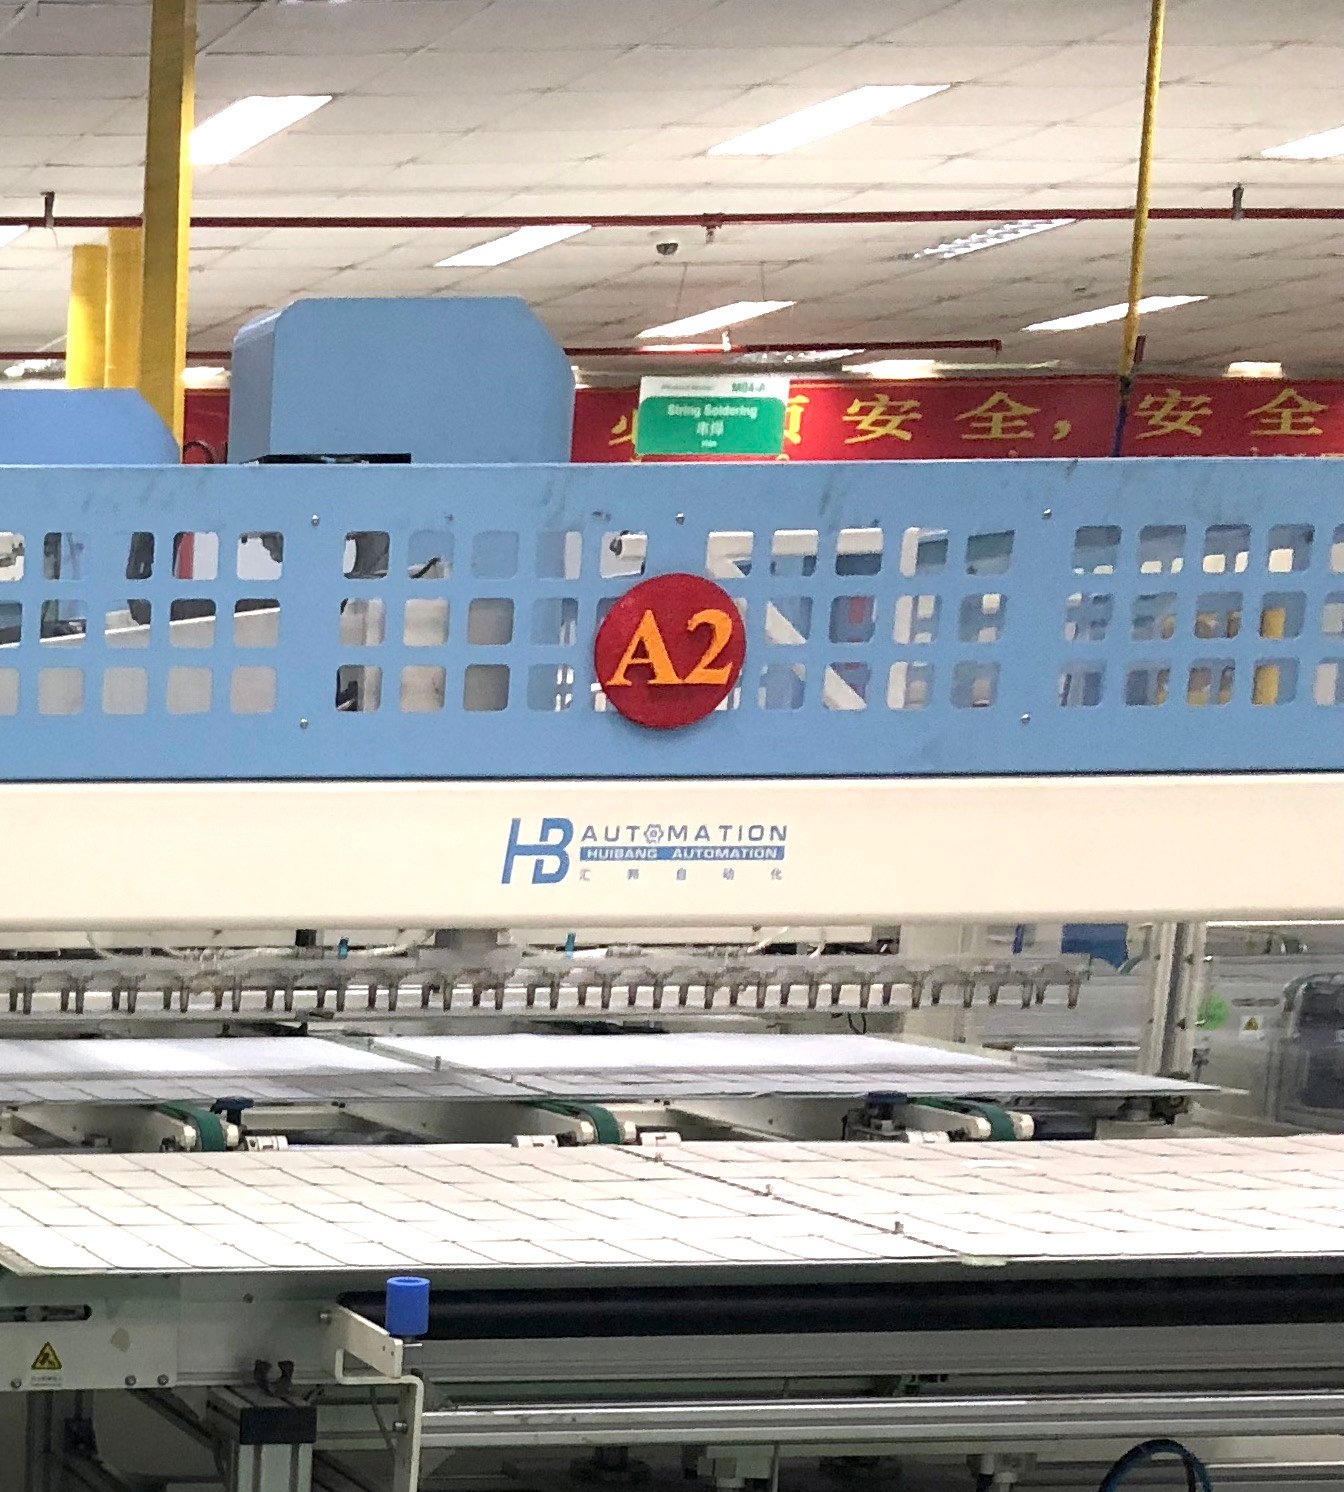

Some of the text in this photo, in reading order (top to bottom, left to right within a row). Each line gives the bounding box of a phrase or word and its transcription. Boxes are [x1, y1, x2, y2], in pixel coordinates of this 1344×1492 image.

[606, 608, 733, 687] A2
[581, 823, 788, 845] AUTOMATION
[587, 848, 777, 860] HUIBANG AUTOMATION
